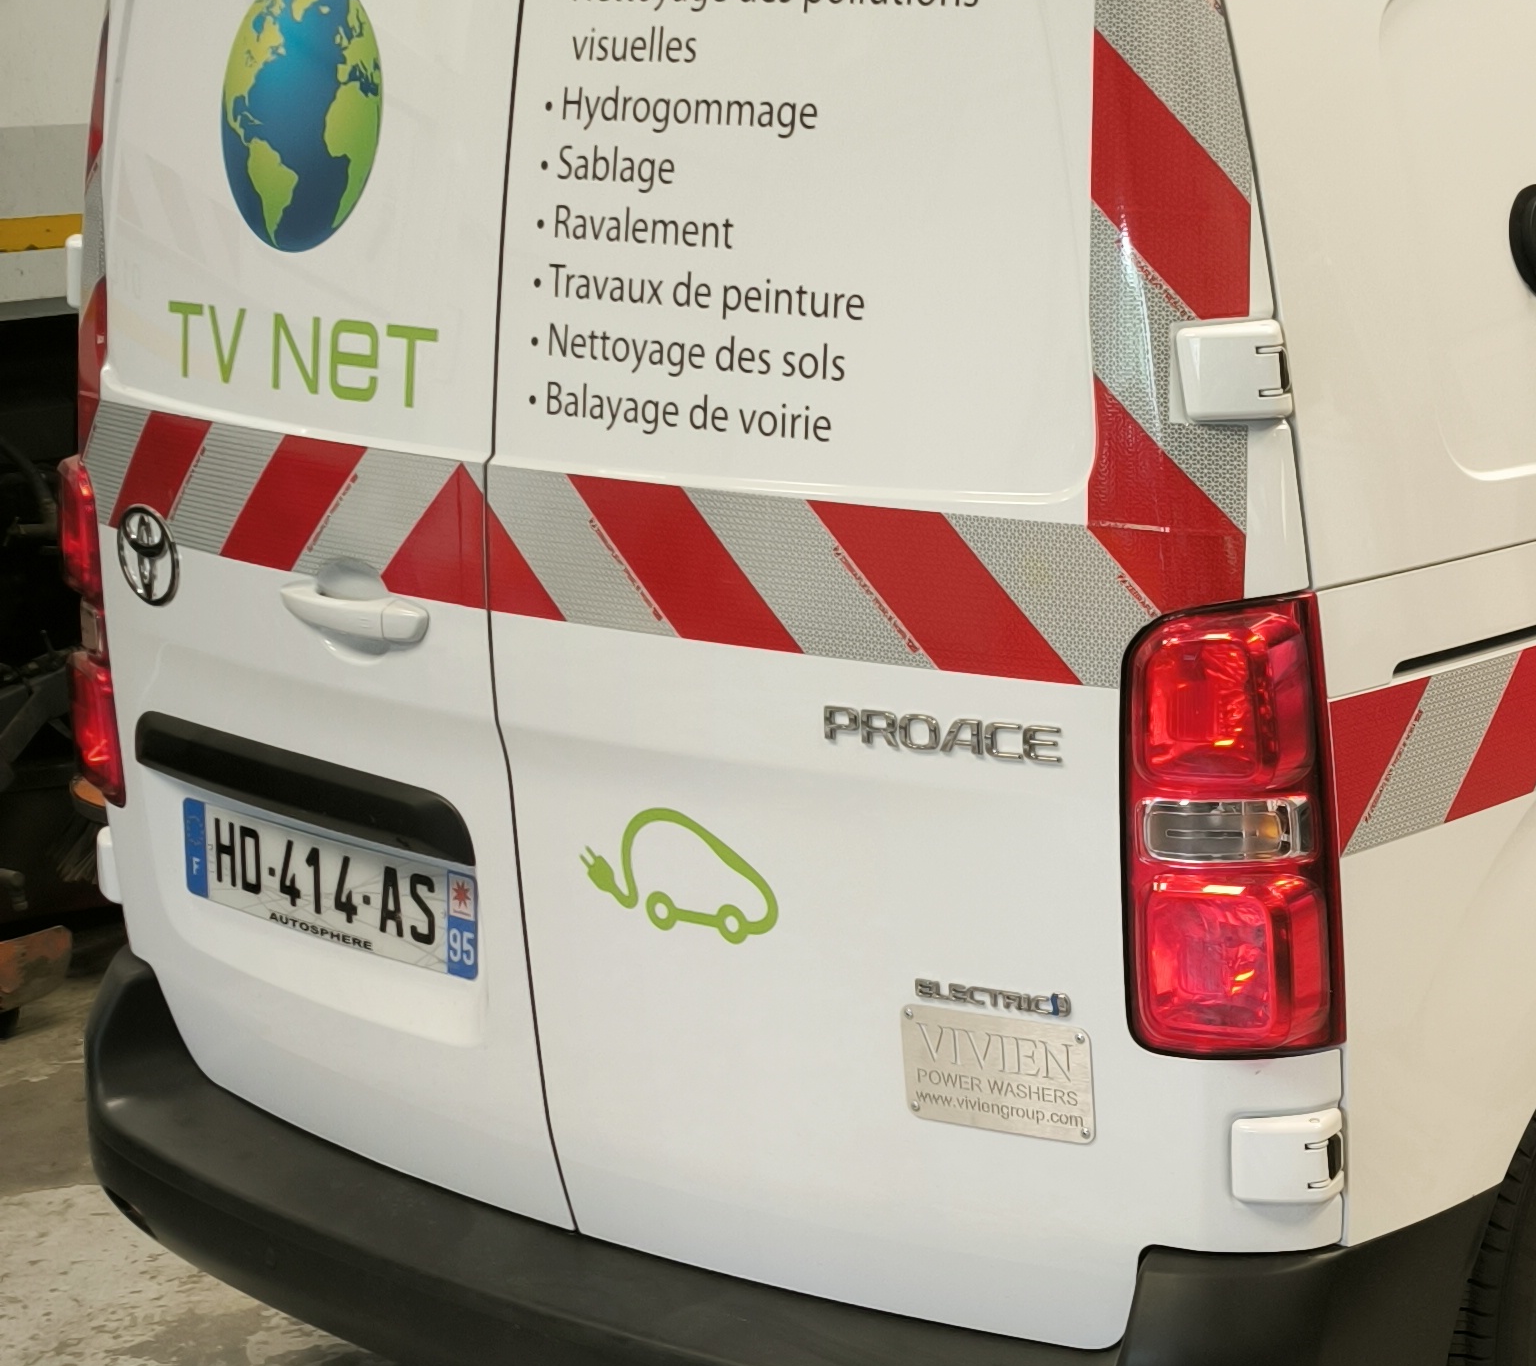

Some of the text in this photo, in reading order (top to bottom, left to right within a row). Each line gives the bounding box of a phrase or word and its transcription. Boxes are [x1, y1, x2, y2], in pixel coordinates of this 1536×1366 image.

[573, 26, 696, 63] visuelles
[563, 86, 817, 138] Hydrogommage
[557, 145, 674, 193] Sablage
[555, 205, 734, 249] Ravalement
[549, 264, 864, 320] Travaux de peinture
[168, 300, 246, 384] TV
[549, 323, 844, 381] Nettoyage des sols
[547, 382, 831, 442] Balayage de voirie
[823, 705, 1063, 764] PROACE
[191, 857, 201, 875] F
[449, 928, 475, 966] 95
[269, 912, 373, 951] AUTOSPHERE
[914, 978, 1054, 1016] ELECTRIC
[916, 1022, 1073, 1082] VIVIEN
[915, 1090, 1084, 1128] www.viviengroup.com
[916, 1068, 1079, 1107] POWER WASHERS
